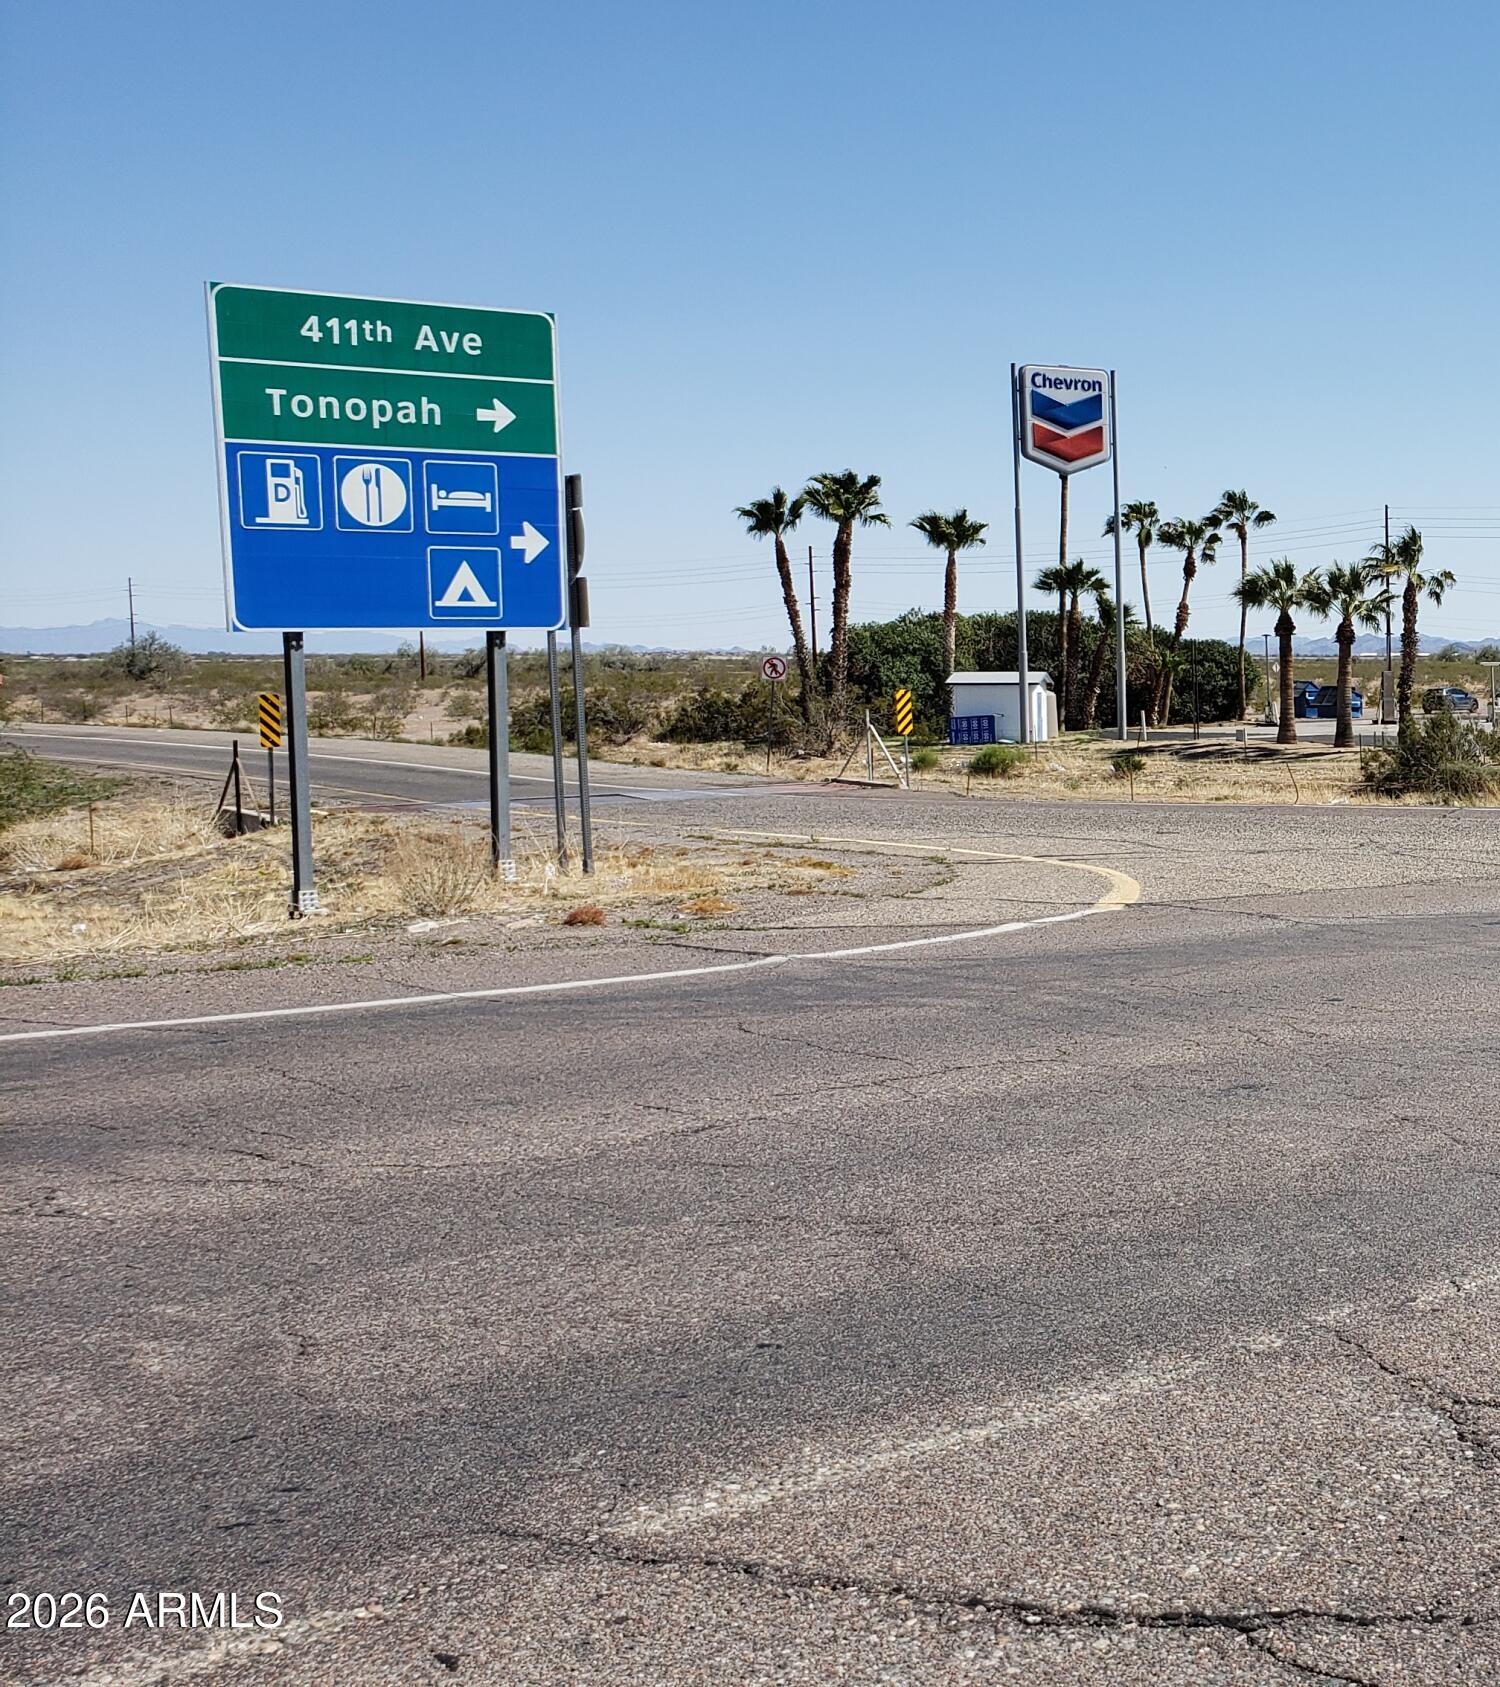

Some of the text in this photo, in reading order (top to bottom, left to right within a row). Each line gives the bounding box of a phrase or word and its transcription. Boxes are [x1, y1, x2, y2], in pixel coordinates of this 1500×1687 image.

[300, 314, 483, 355] 411th Ave
[1031, 372, 1102, 392] Chevron
[265, 388, 441, 429] Tonopah
